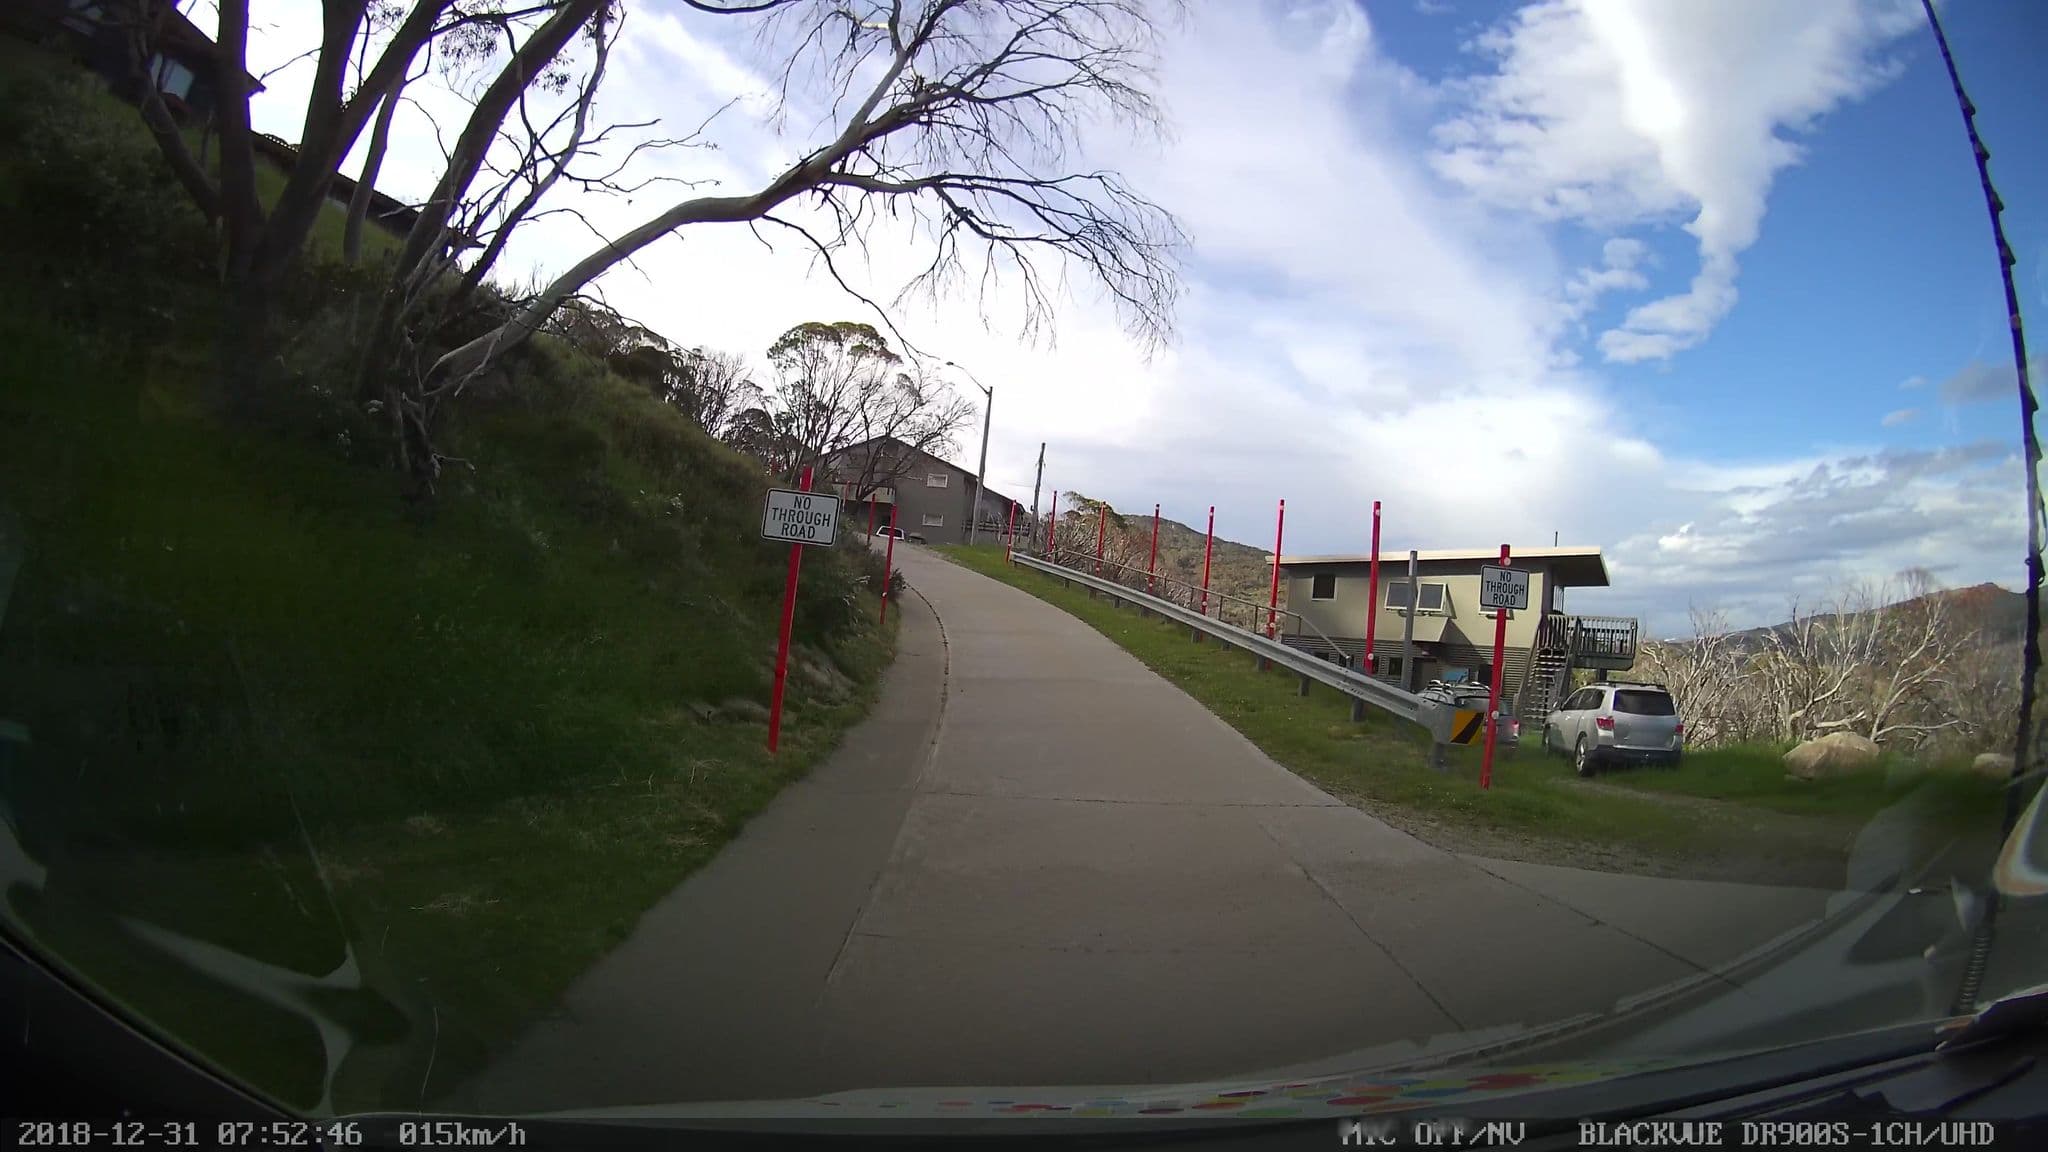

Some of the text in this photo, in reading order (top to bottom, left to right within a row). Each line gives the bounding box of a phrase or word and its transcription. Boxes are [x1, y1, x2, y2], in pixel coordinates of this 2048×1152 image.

[794, 496, 811, 510] NO
[772, 507, 831, 527] THROUGH
[781, 523, 815, 539] ROAD
[1500, 571, 1511, 582] NO
[1486, 581, 1524, 596] THROUGH
[1493, 593, 1515, 605] ROAD
